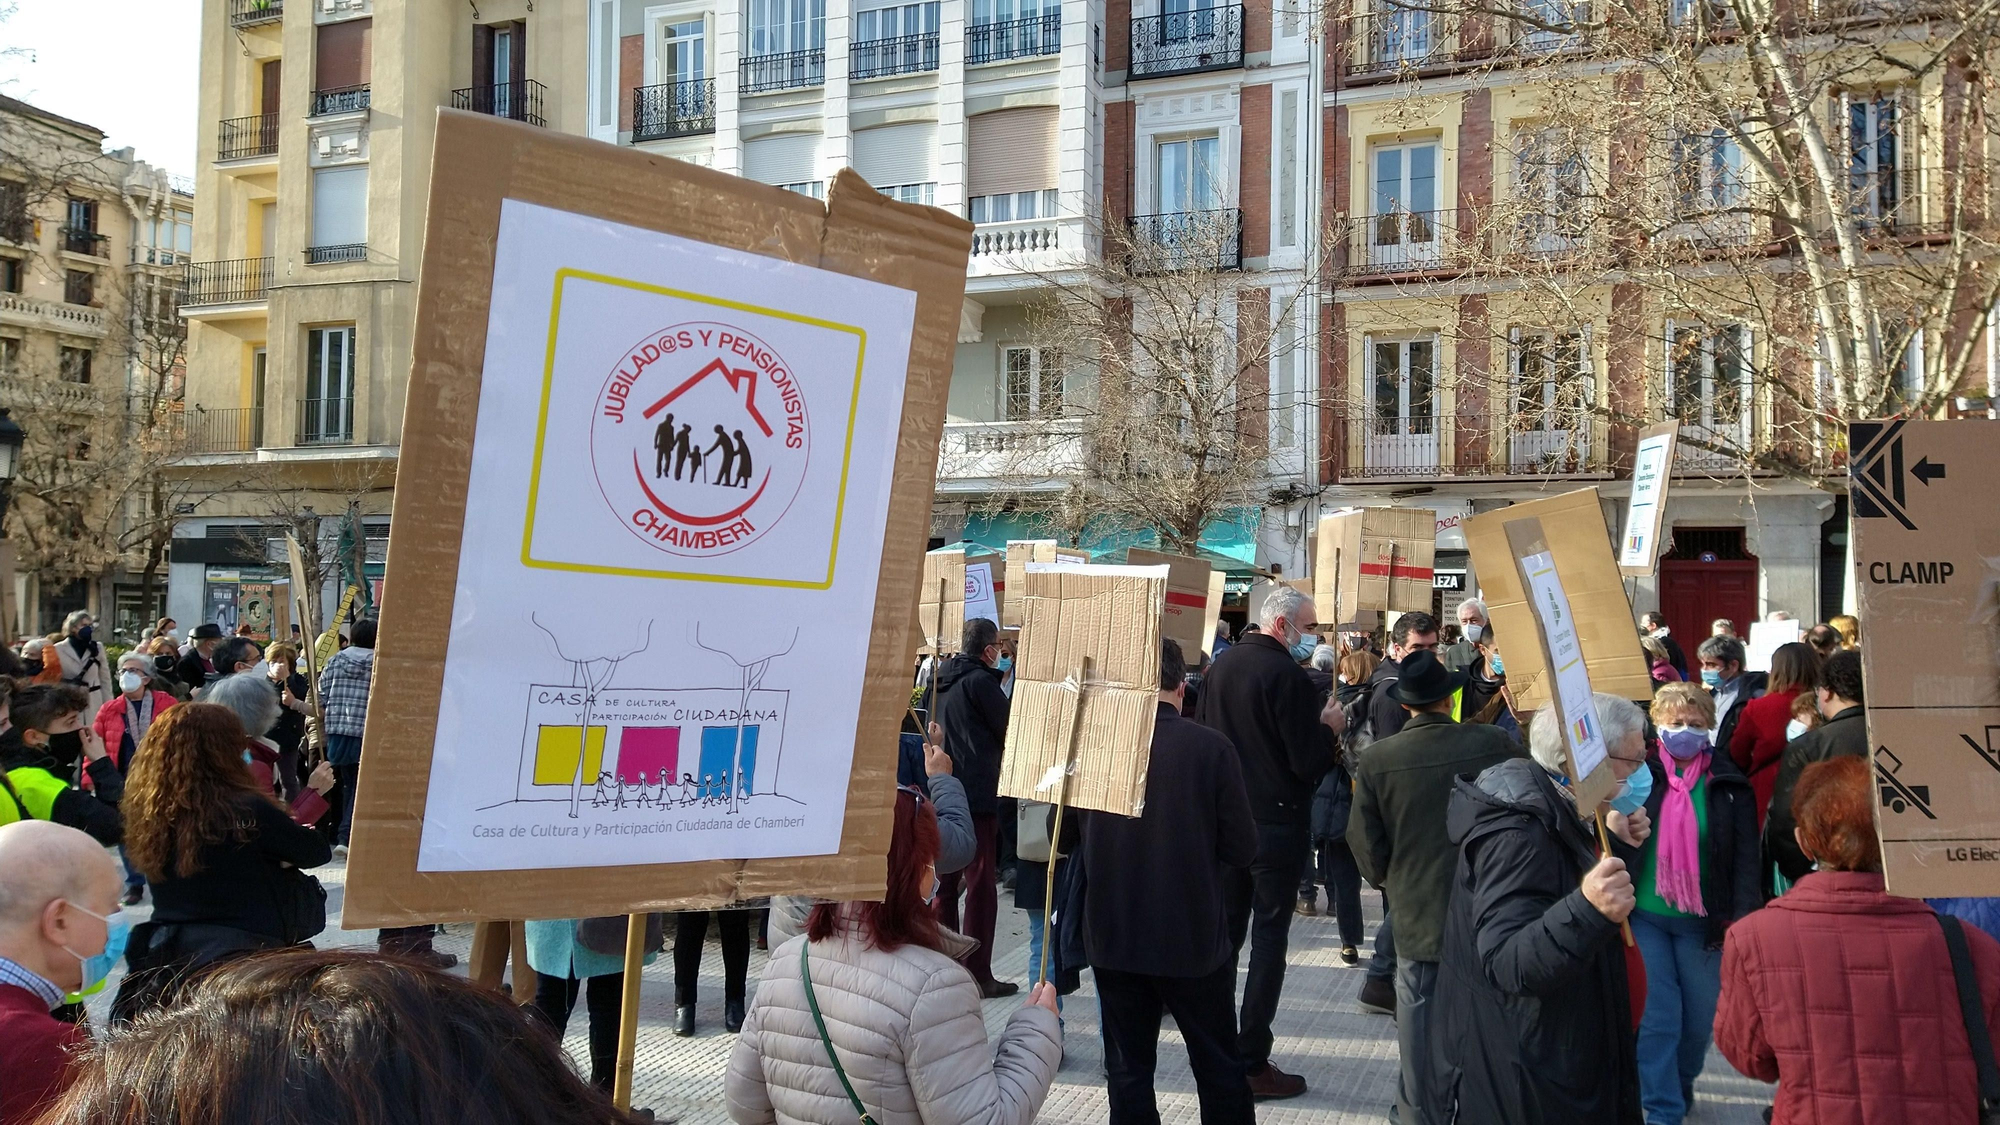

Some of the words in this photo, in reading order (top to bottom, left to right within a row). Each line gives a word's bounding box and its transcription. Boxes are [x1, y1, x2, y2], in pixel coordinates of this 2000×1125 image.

[604, 331, 693, 424] JUBILAD@S
[698, 329, 713, 347] Y
[718, 332, 804, 449] PENSIONISTAS
[632, 508, 756, 549] CHAMBERÍ
[1869, 561, 1955, 585] CLAMP
[538, 691, 598, 707] CASA
[605, 699, 620, 707] DE
[626, 698, 677, 708] CULTURA
[574, 712, 582, 722] Y
[591, 711, 667, 722] PARTICIPACIÓN
[673, 708, 779, 723] CIUDADANA
[472, 824, 505, 839] Casa
[509, 824, 526, 838] de
[530, 822, 579, 838] Cultura
[582, 826, 591, 839] y
[594, 820, 673, 838] Participación
[676, 818, 734, 833] Ciudadana
[736, 816, 751, 830] de
[754, 814, 806, 829] Chamberí
[1946, 848, 1968, 862] LG
[1971, 847, 2000, 861] Elec
